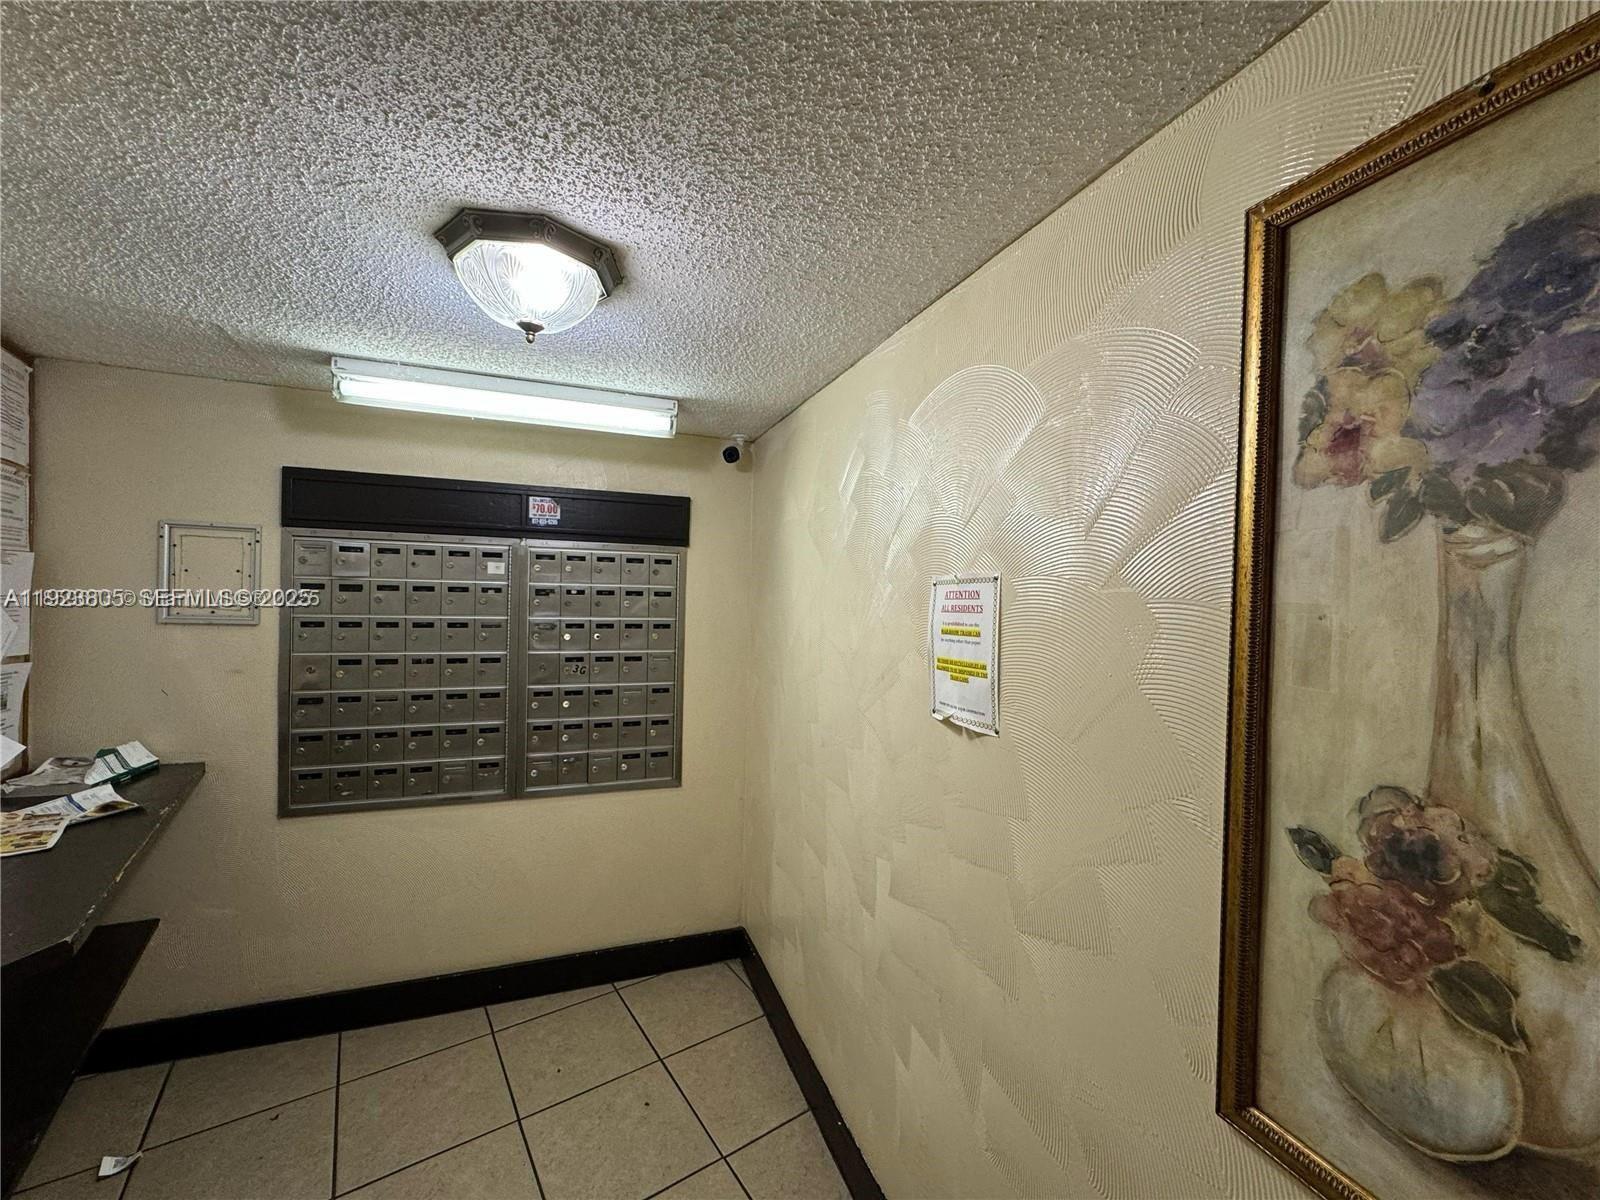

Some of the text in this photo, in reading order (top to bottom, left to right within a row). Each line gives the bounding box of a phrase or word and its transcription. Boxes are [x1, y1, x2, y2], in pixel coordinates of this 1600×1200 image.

[944, 590, 981, 600] ATTENTION
[940, 603, 984, 614] ALL RESIDENTS
